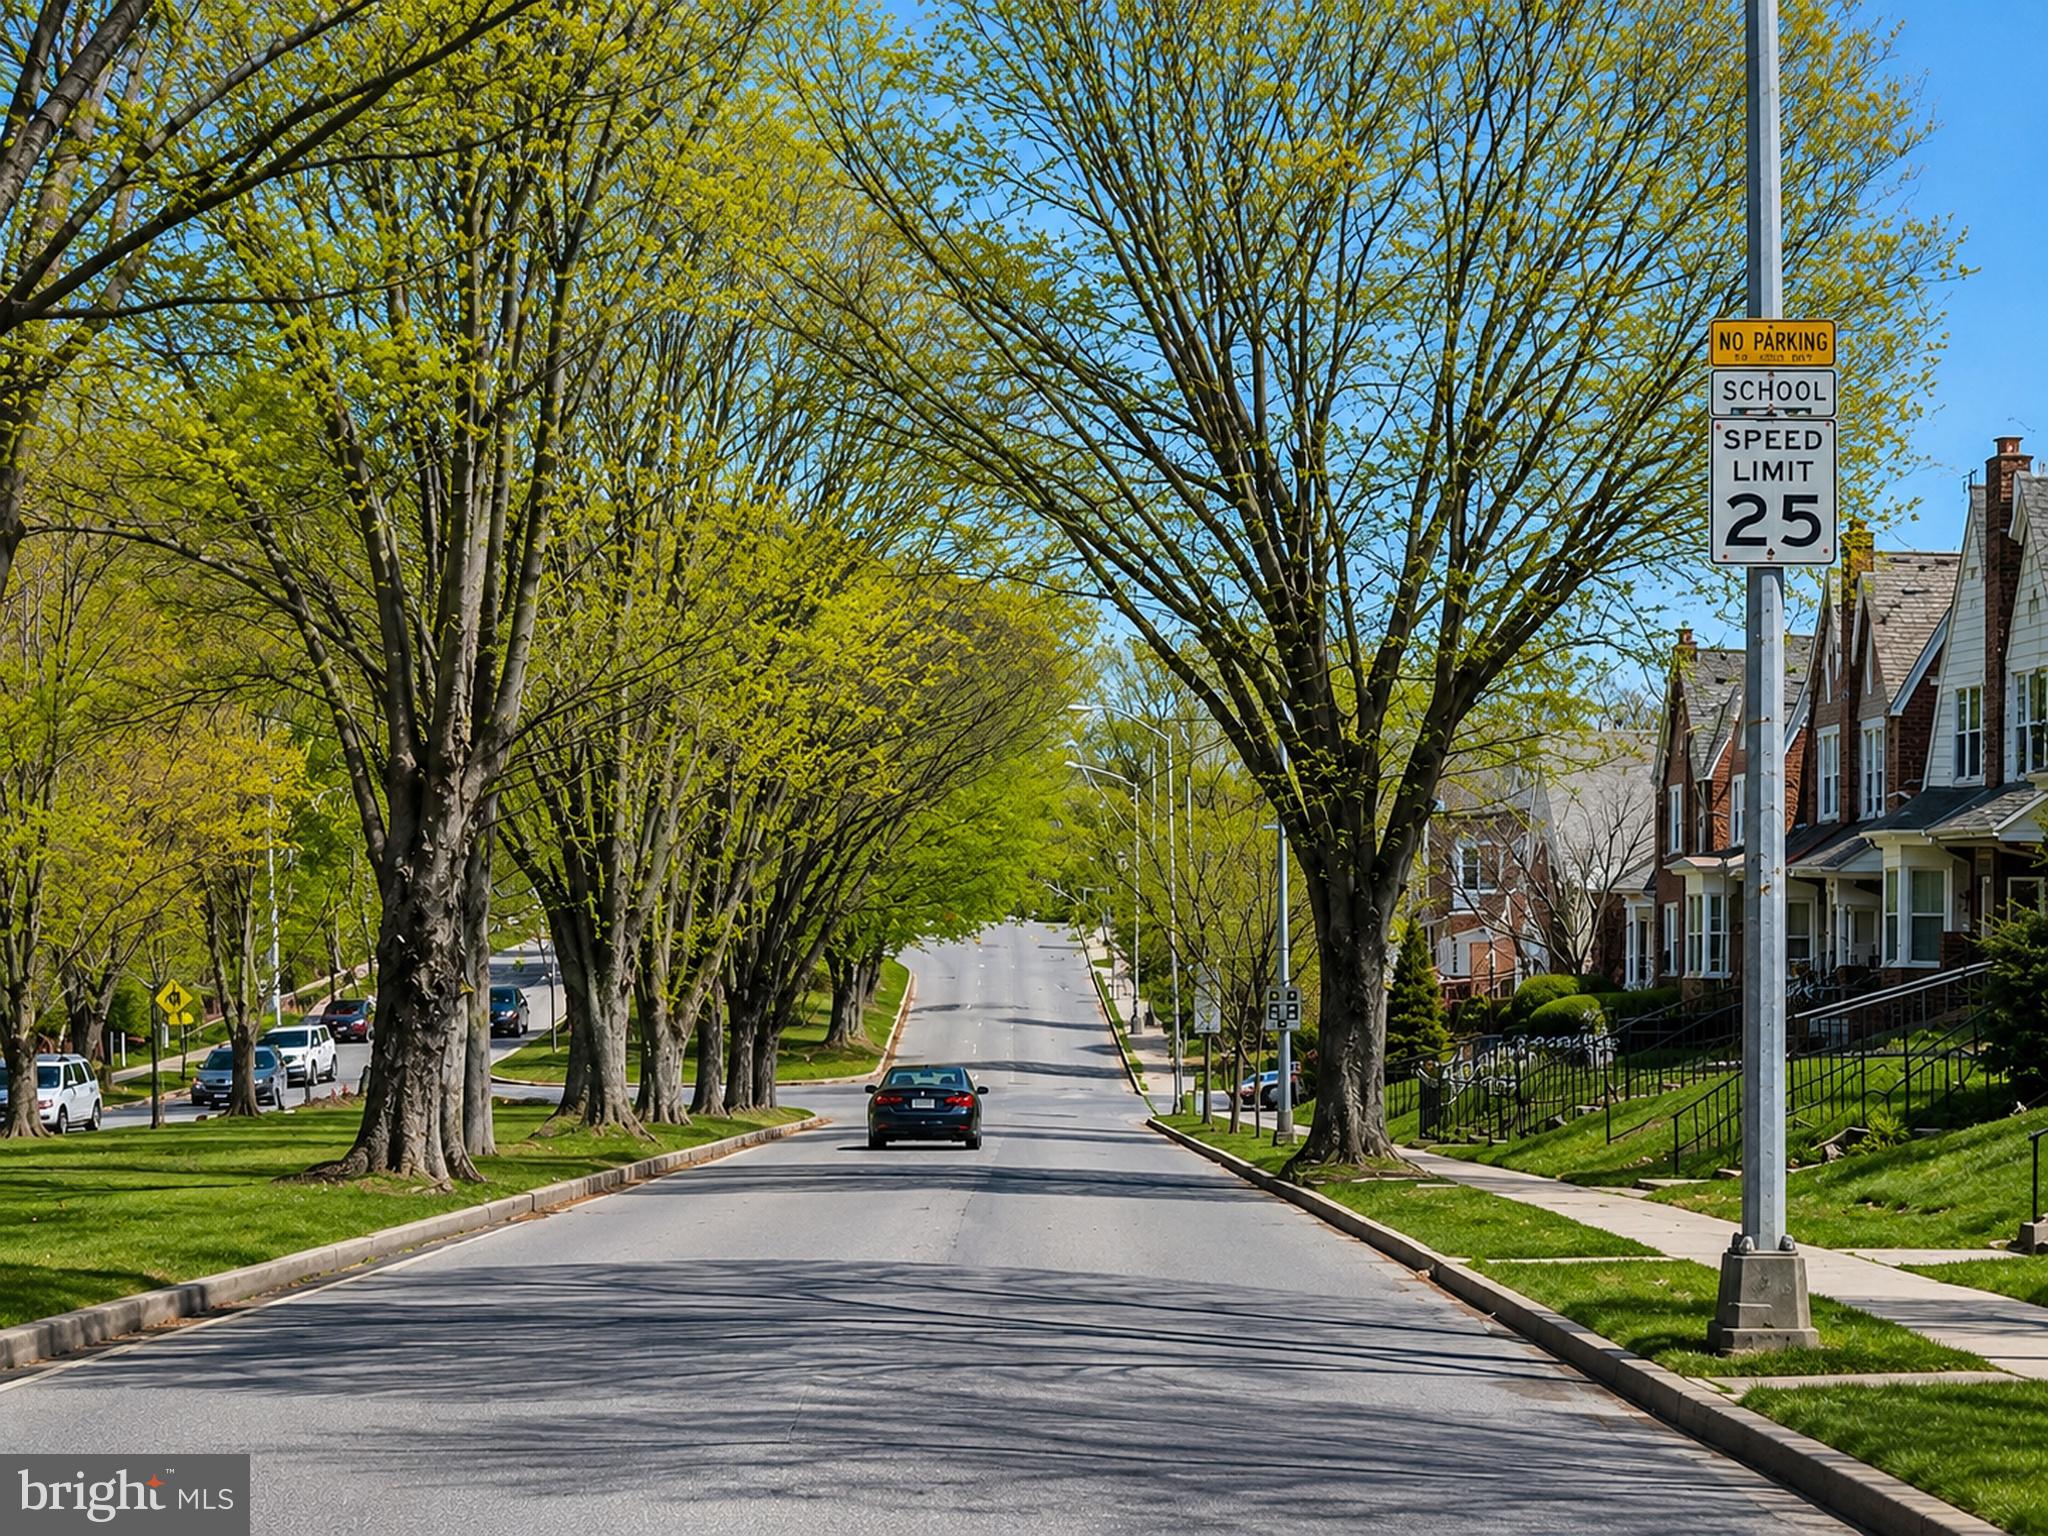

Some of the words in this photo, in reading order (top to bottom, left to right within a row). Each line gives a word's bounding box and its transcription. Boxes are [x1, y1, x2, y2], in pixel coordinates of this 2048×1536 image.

[1720, 331, 1743, 351] NO
[1754, 331, 1828, 351] PARKING
[1723, 380, 1826, 401] SCHOOL
[1724, 429, 1822, 450] SPEED
[1734, 460, 1814, 481] LIMIT
[1725, 493, 1821, 547] 25
